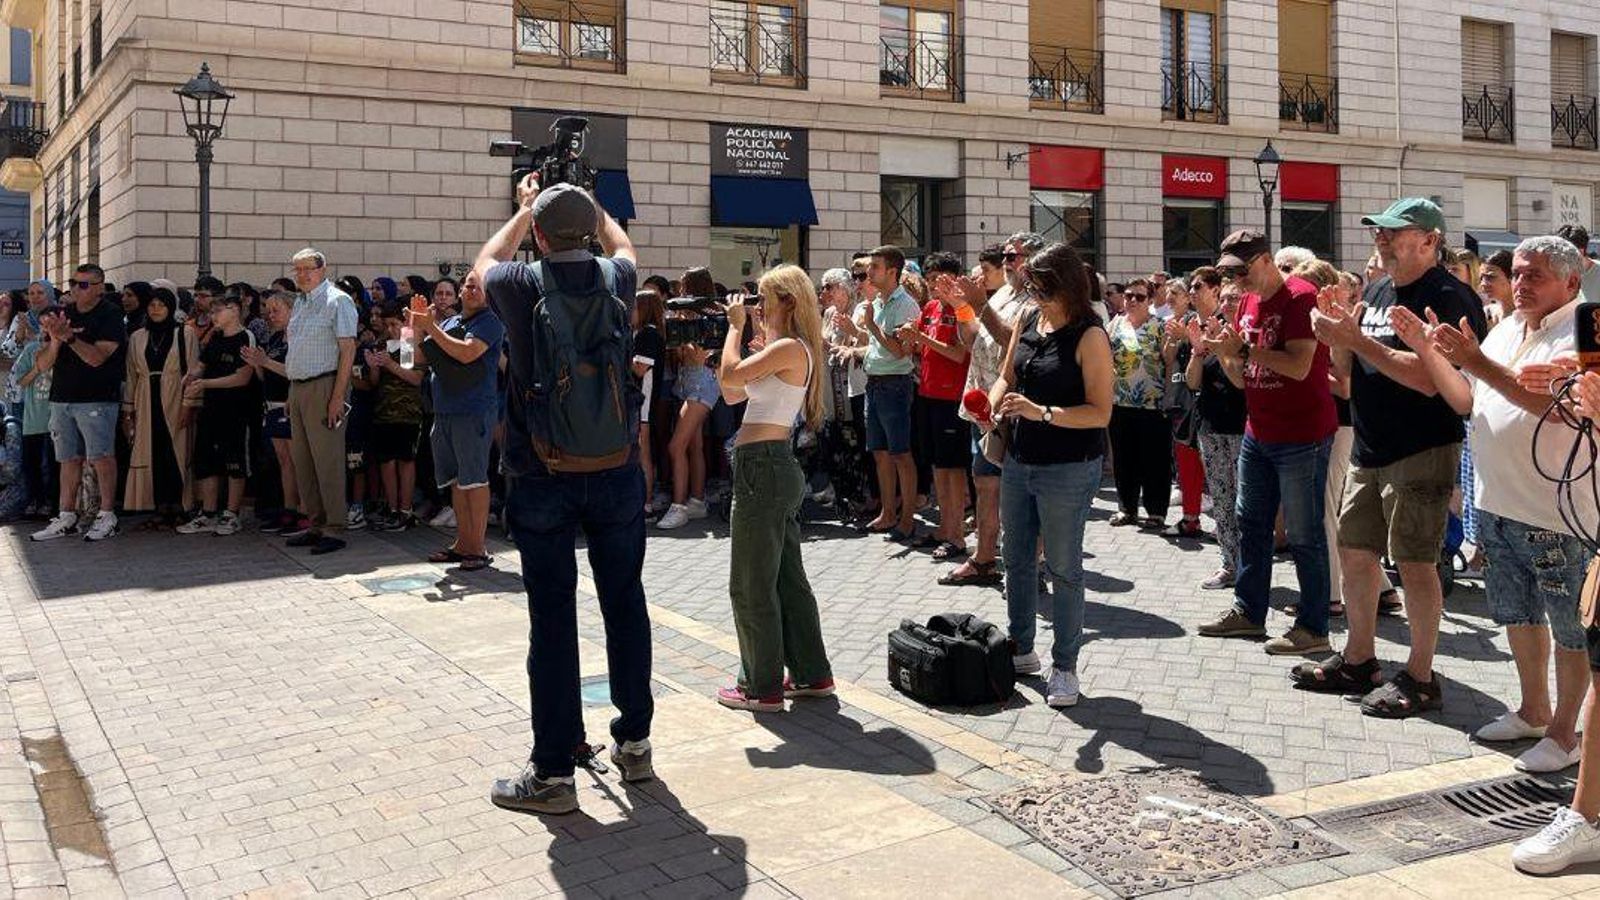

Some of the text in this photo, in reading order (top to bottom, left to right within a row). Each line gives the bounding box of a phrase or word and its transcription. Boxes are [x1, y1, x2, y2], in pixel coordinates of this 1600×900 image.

[726, 127, 792, 140] ACADEMIA
[726, 148, 791, 160] NACIONAL
[1171, 167, 1214, 183] Adecco
